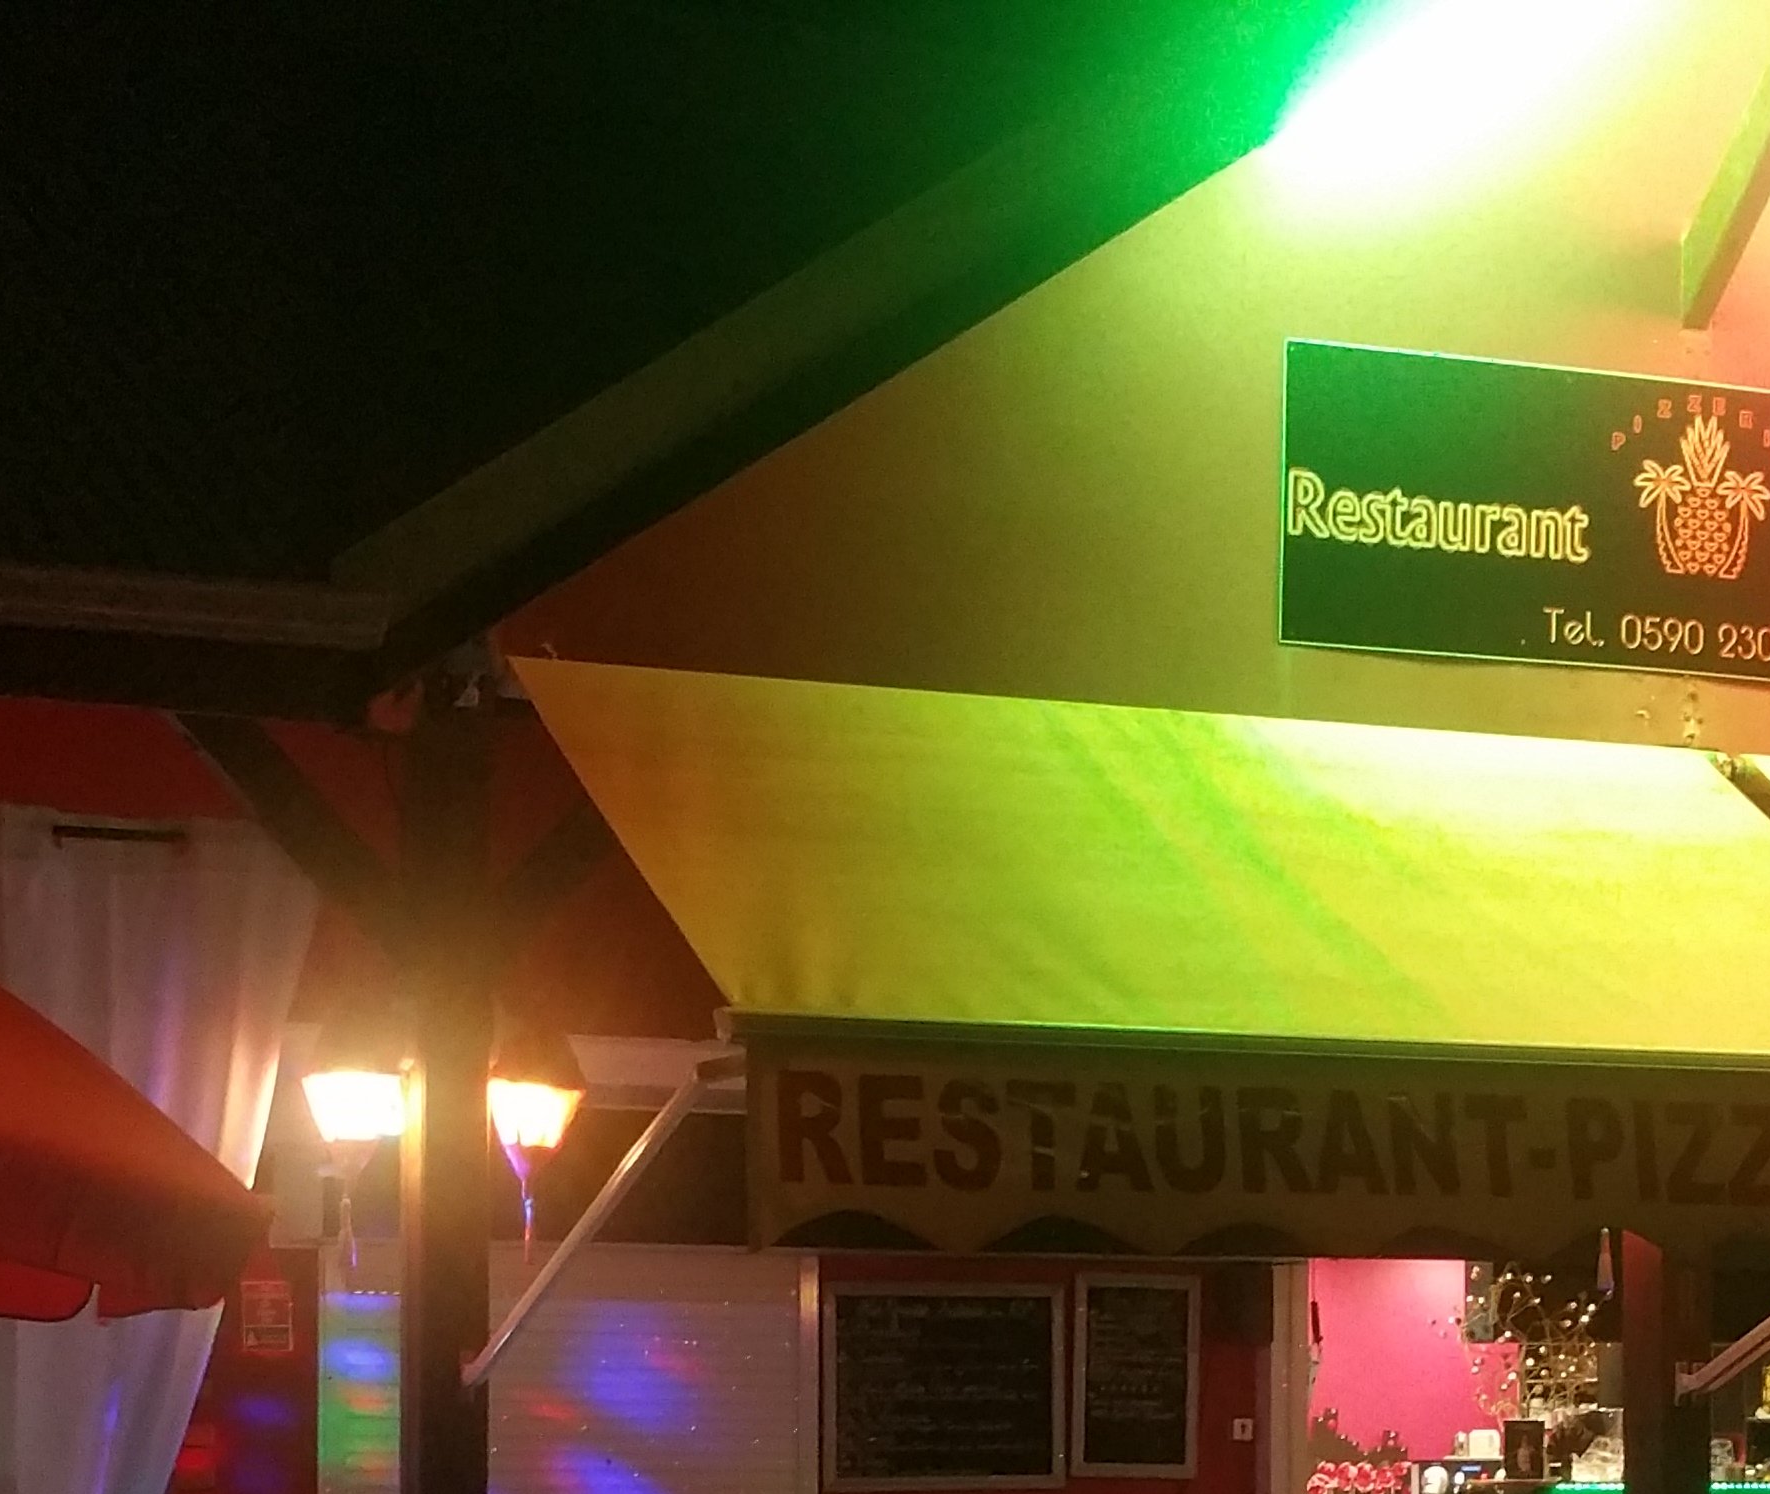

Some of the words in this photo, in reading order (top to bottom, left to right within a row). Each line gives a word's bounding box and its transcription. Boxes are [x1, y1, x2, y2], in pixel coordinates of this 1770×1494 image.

[1287, 467, 1590, 564] Restaurant
[1543, 606, 1604, 648] Tel.
[1620, 614, 1704, 656] 0590
